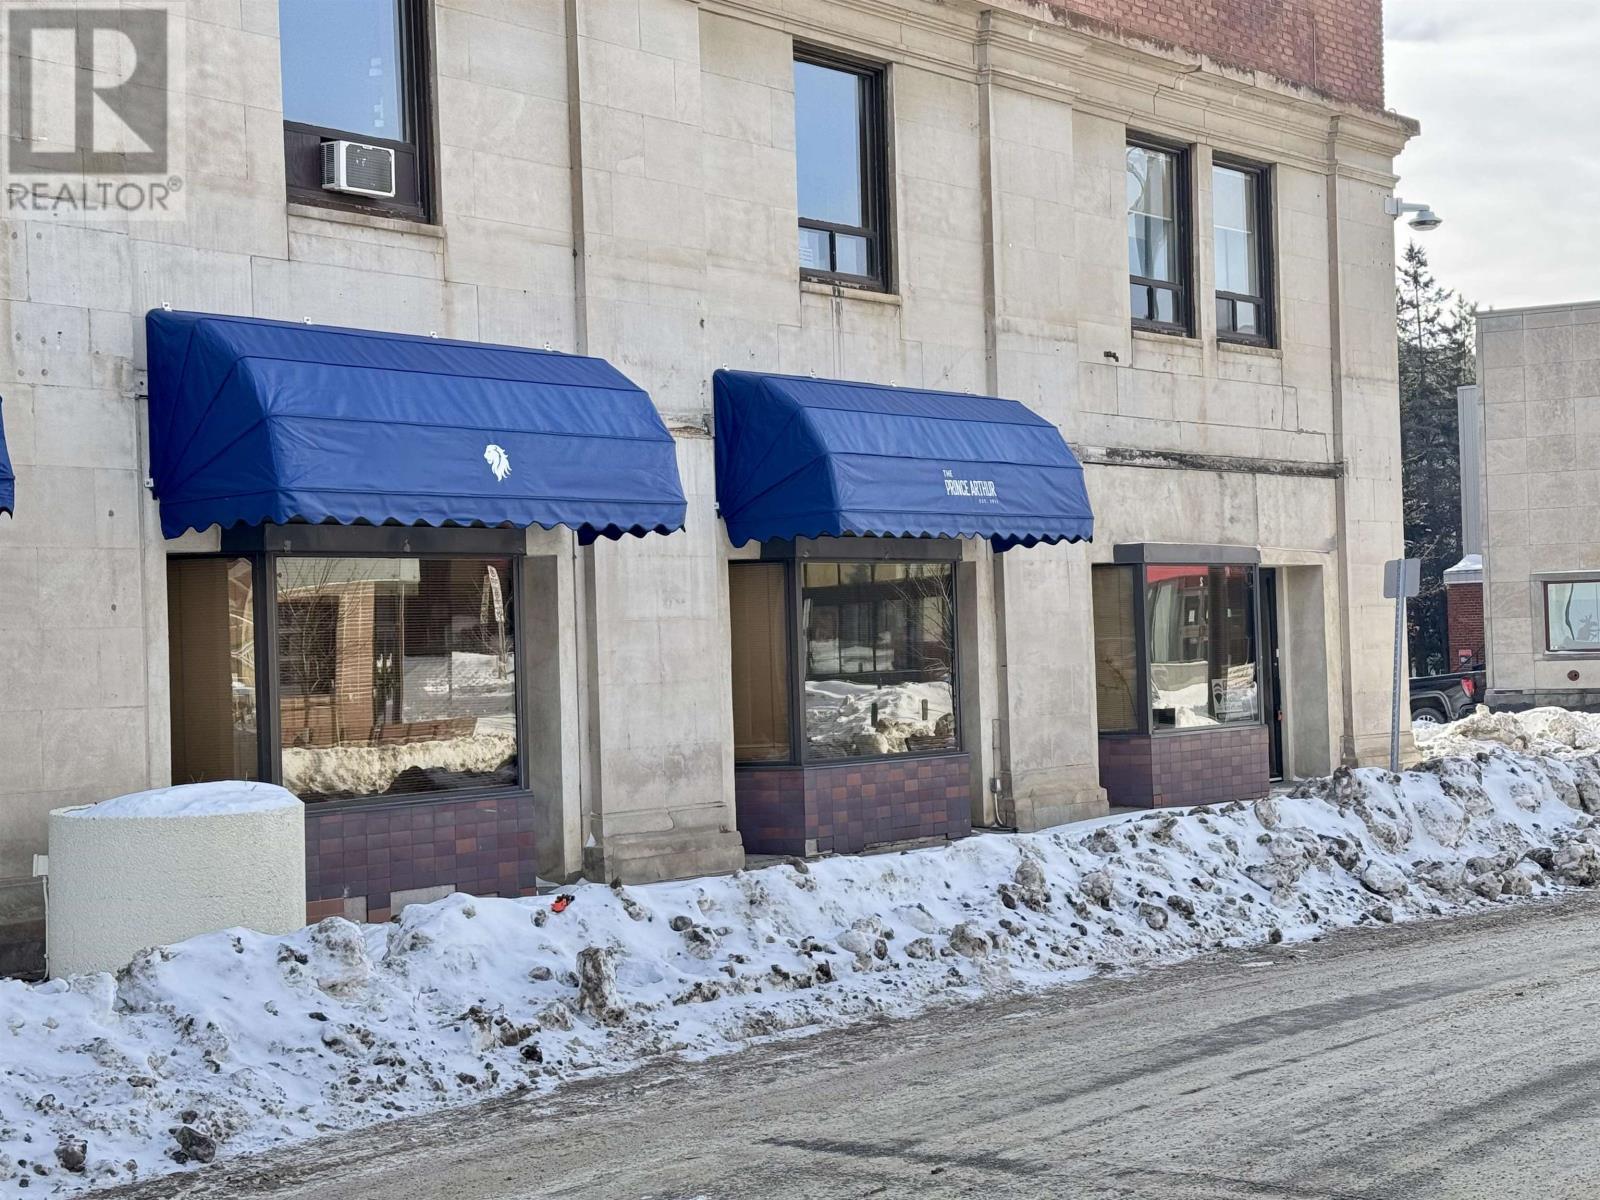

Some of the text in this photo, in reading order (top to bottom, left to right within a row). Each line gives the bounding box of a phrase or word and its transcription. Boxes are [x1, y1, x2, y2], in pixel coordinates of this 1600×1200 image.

[942, 469, 953, 478] THE
[944, 479, 997, 497] PRINCE ARTHUR
